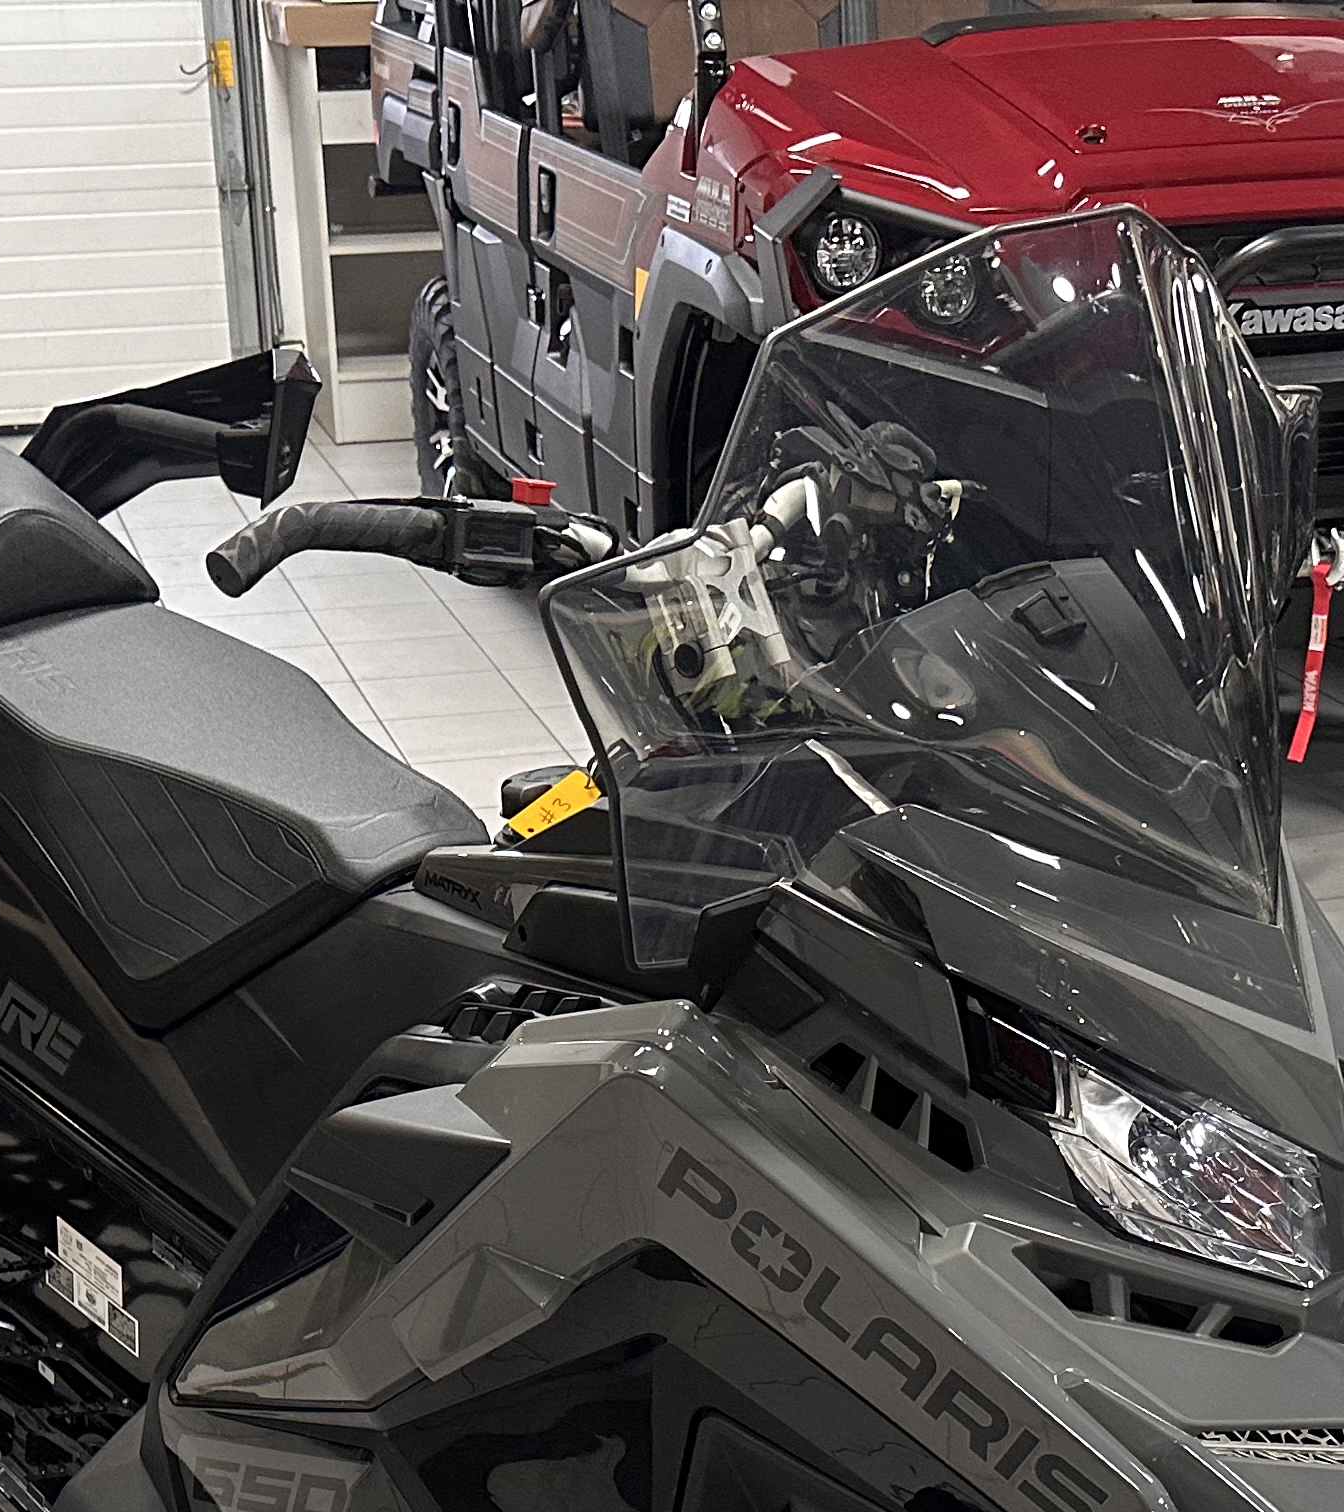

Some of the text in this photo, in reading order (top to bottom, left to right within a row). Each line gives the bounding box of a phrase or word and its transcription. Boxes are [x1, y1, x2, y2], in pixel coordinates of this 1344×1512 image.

[1302, 670, 1318, 712] WARN
[538, 798, 572, 825] #3
[423, 869, 483, 910] MATRYX
